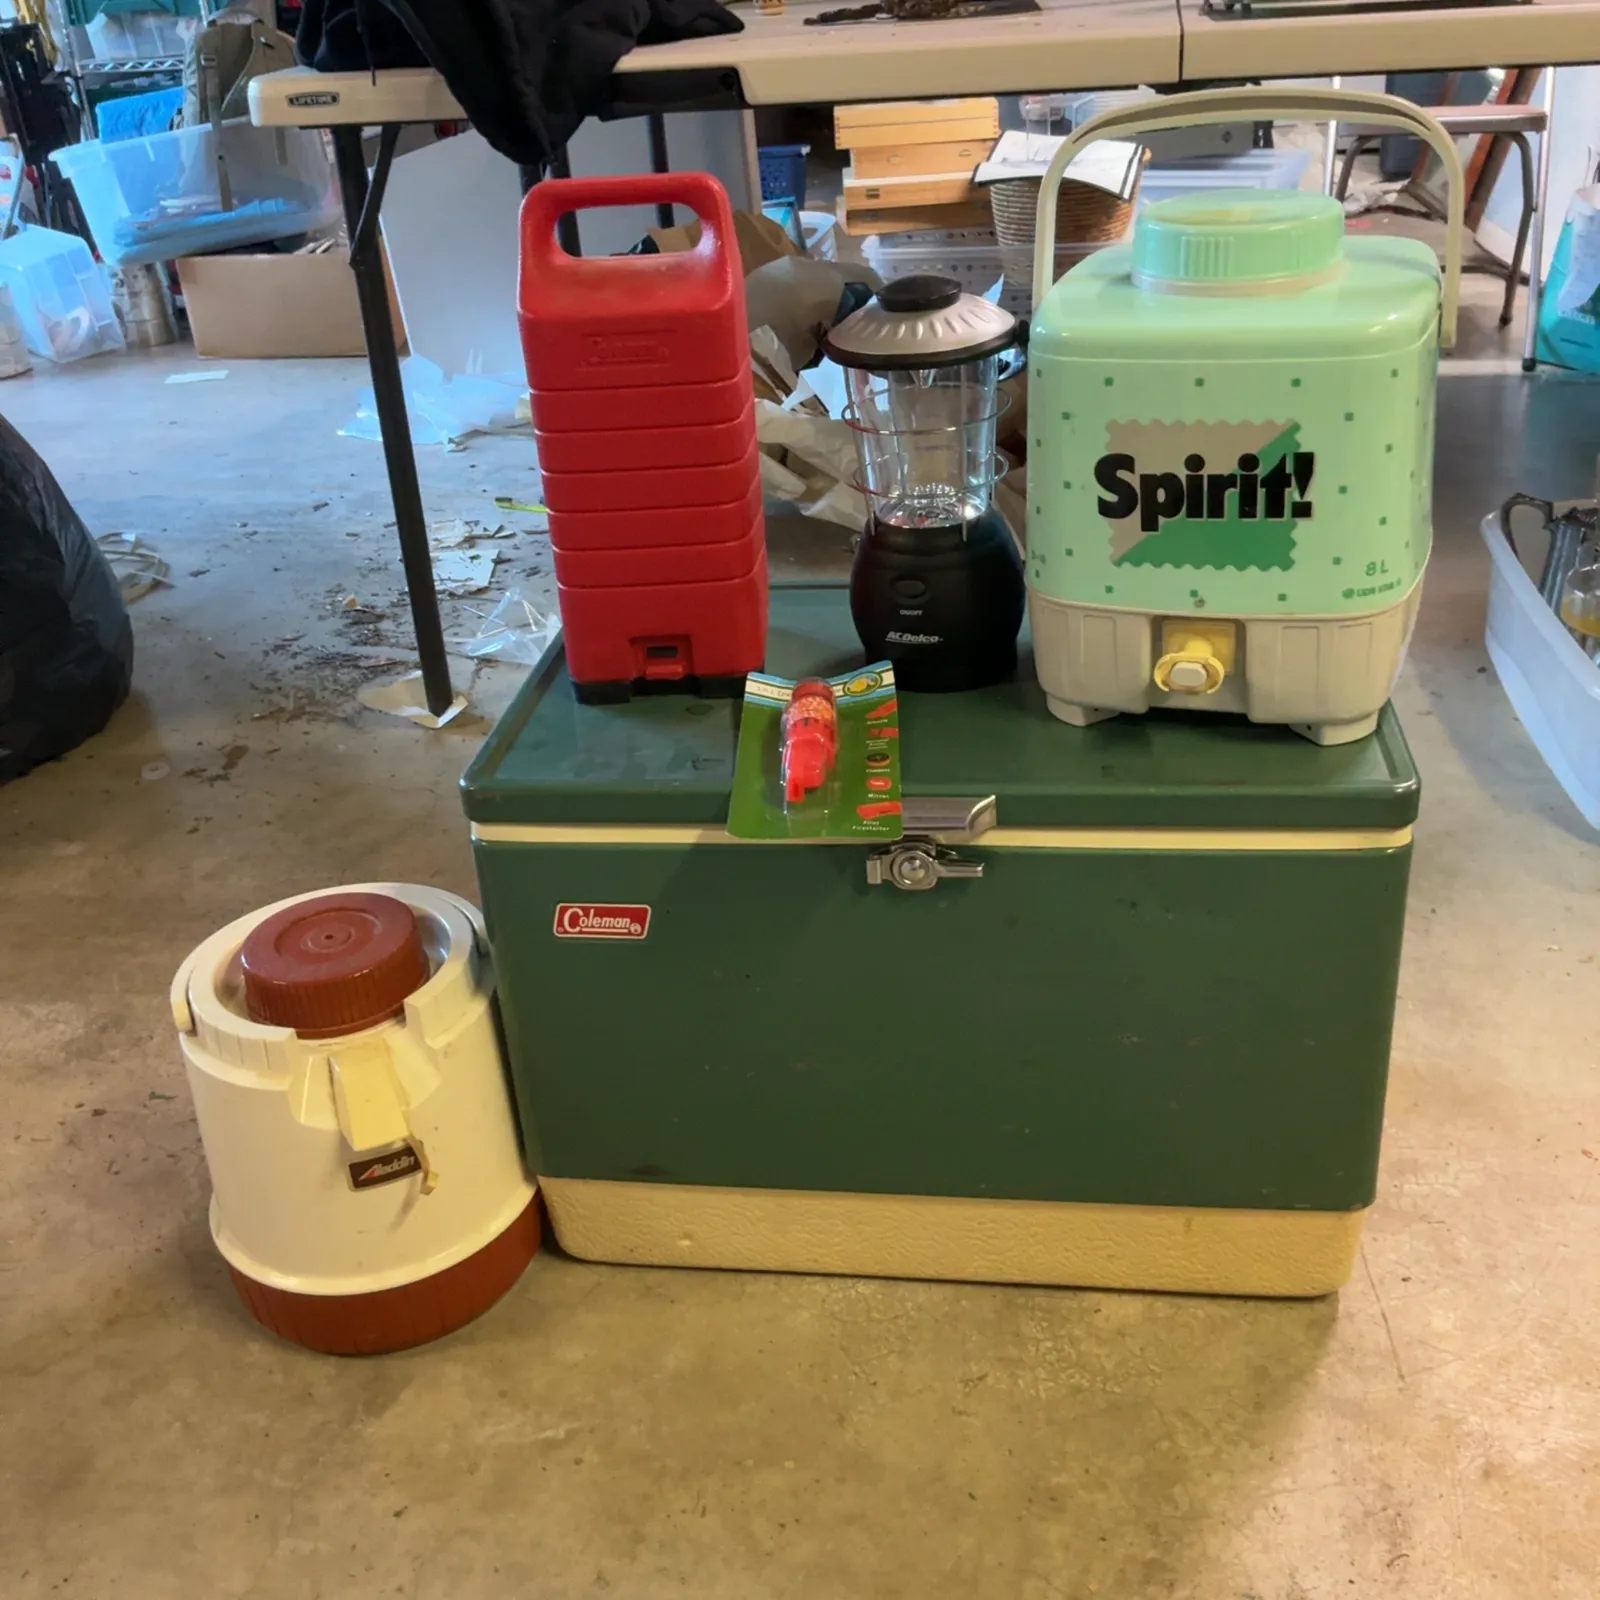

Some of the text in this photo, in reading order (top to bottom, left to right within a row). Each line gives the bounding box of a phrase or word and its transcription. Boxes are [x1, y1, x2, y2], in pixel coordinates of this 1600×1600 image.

[293, 95, 333, 105] LIFETIME
[1094, 451, 1315, 532] Spirit!
[1365, 560, 1389, 576] 8 L
[885, 631, 939, 644] ACDelco
[563, 907, 631, 932] Coleman
